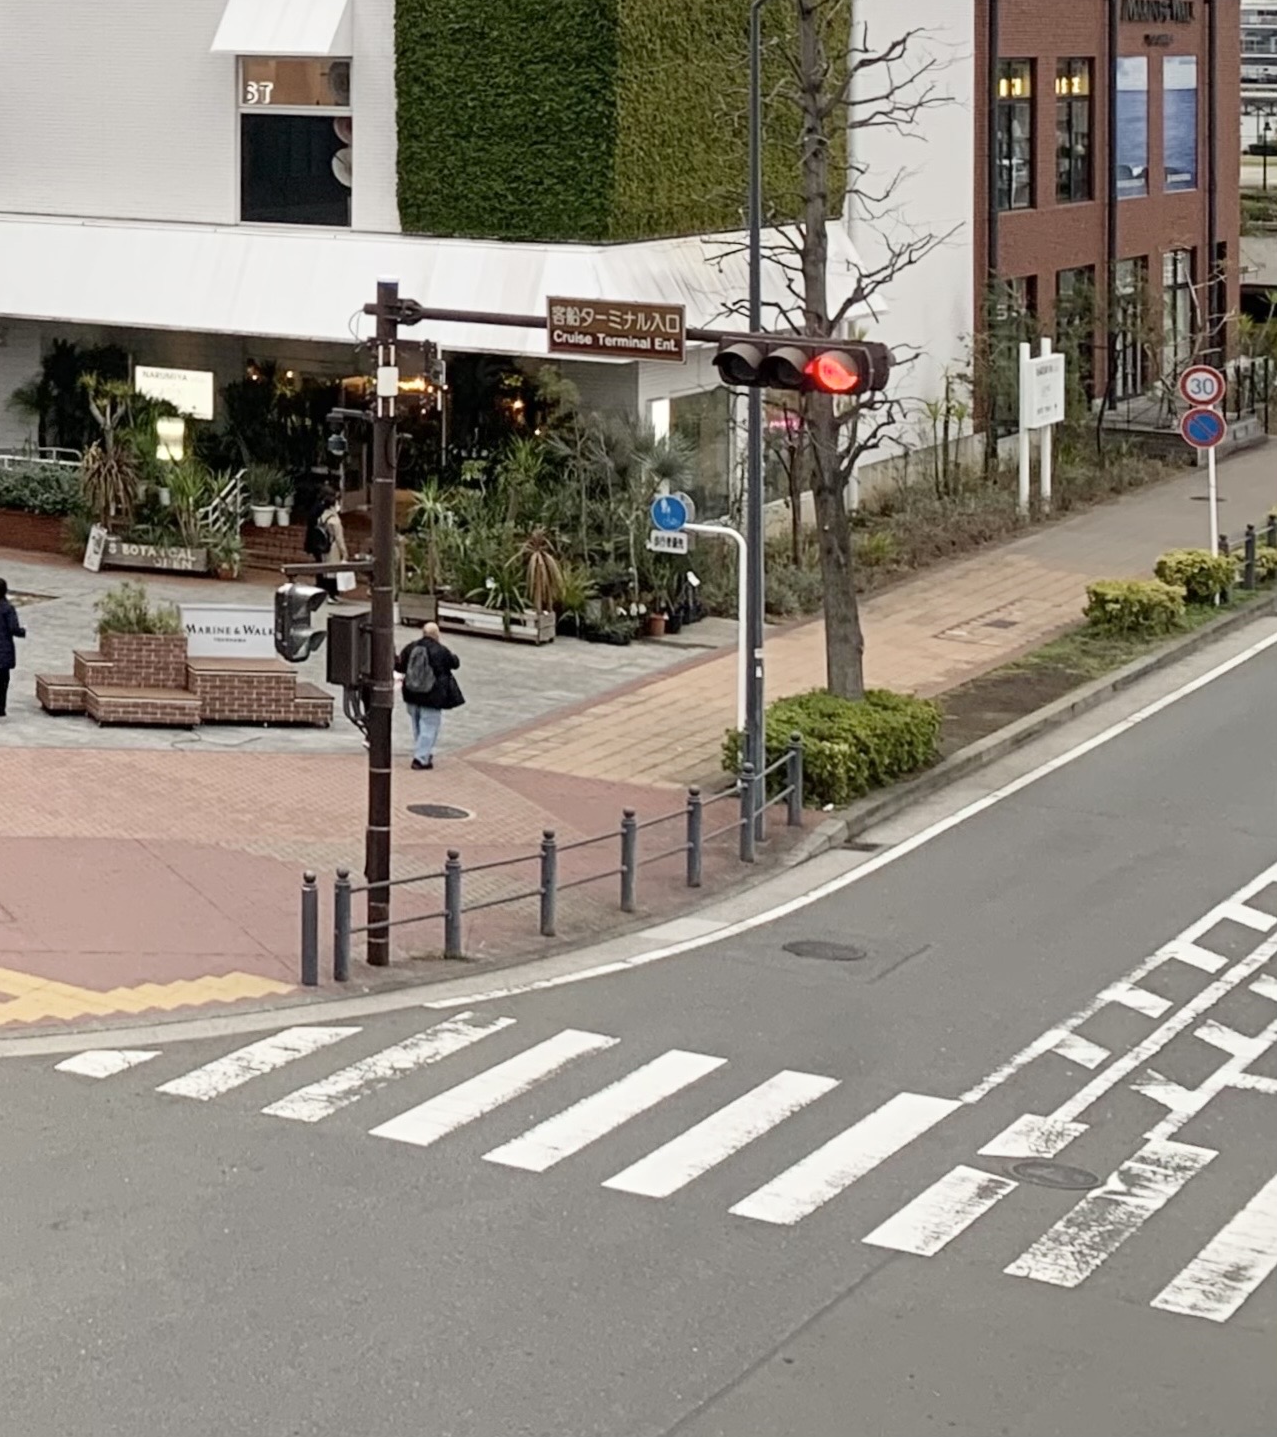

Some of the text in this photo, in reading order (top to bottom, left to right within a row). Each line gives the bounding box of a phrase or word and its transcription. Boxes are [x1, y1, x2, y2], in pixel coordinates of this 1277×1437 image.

[551, 305, 680, 333] 客船ターミナル入口
[553, 330, 679, 352] Cruise Terminal Ent.
[1190, 378, 1214, 395] 30
[186, 624, 231, 635] MARINE
